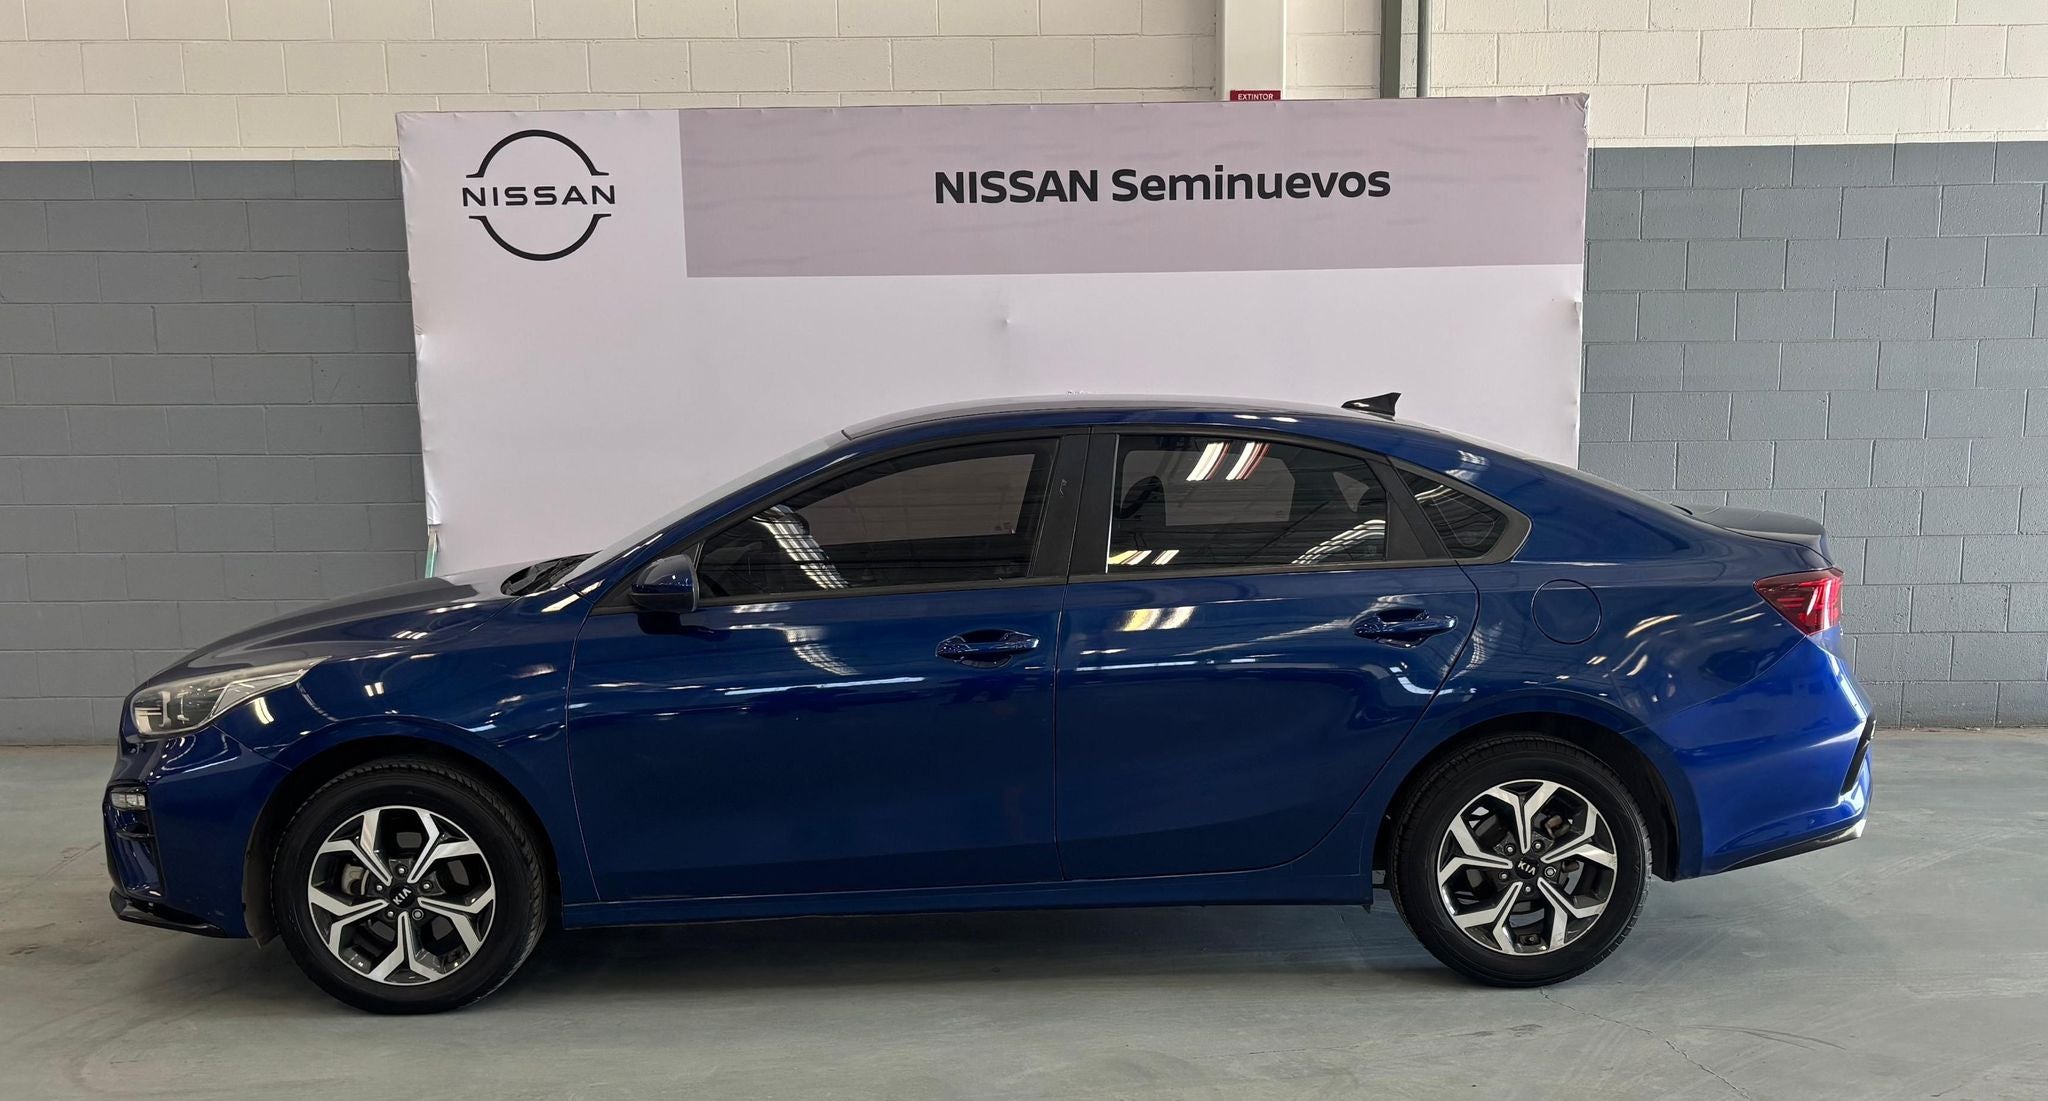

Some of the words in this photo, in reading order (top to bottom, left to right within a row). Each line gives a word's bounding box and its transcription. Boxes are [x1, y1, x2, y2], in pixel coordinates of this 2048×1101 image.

[1237, 93, 1274, 101] EXTINTOR
[936, 169, 1098, 204] NISSAN
[1111, 164, 1391, 202] Seminuevos
[462, 185, 616, 207] NISSAN
[1517, 860, 1536, 876] KIA
[392, 887, 412, 905] KIA
